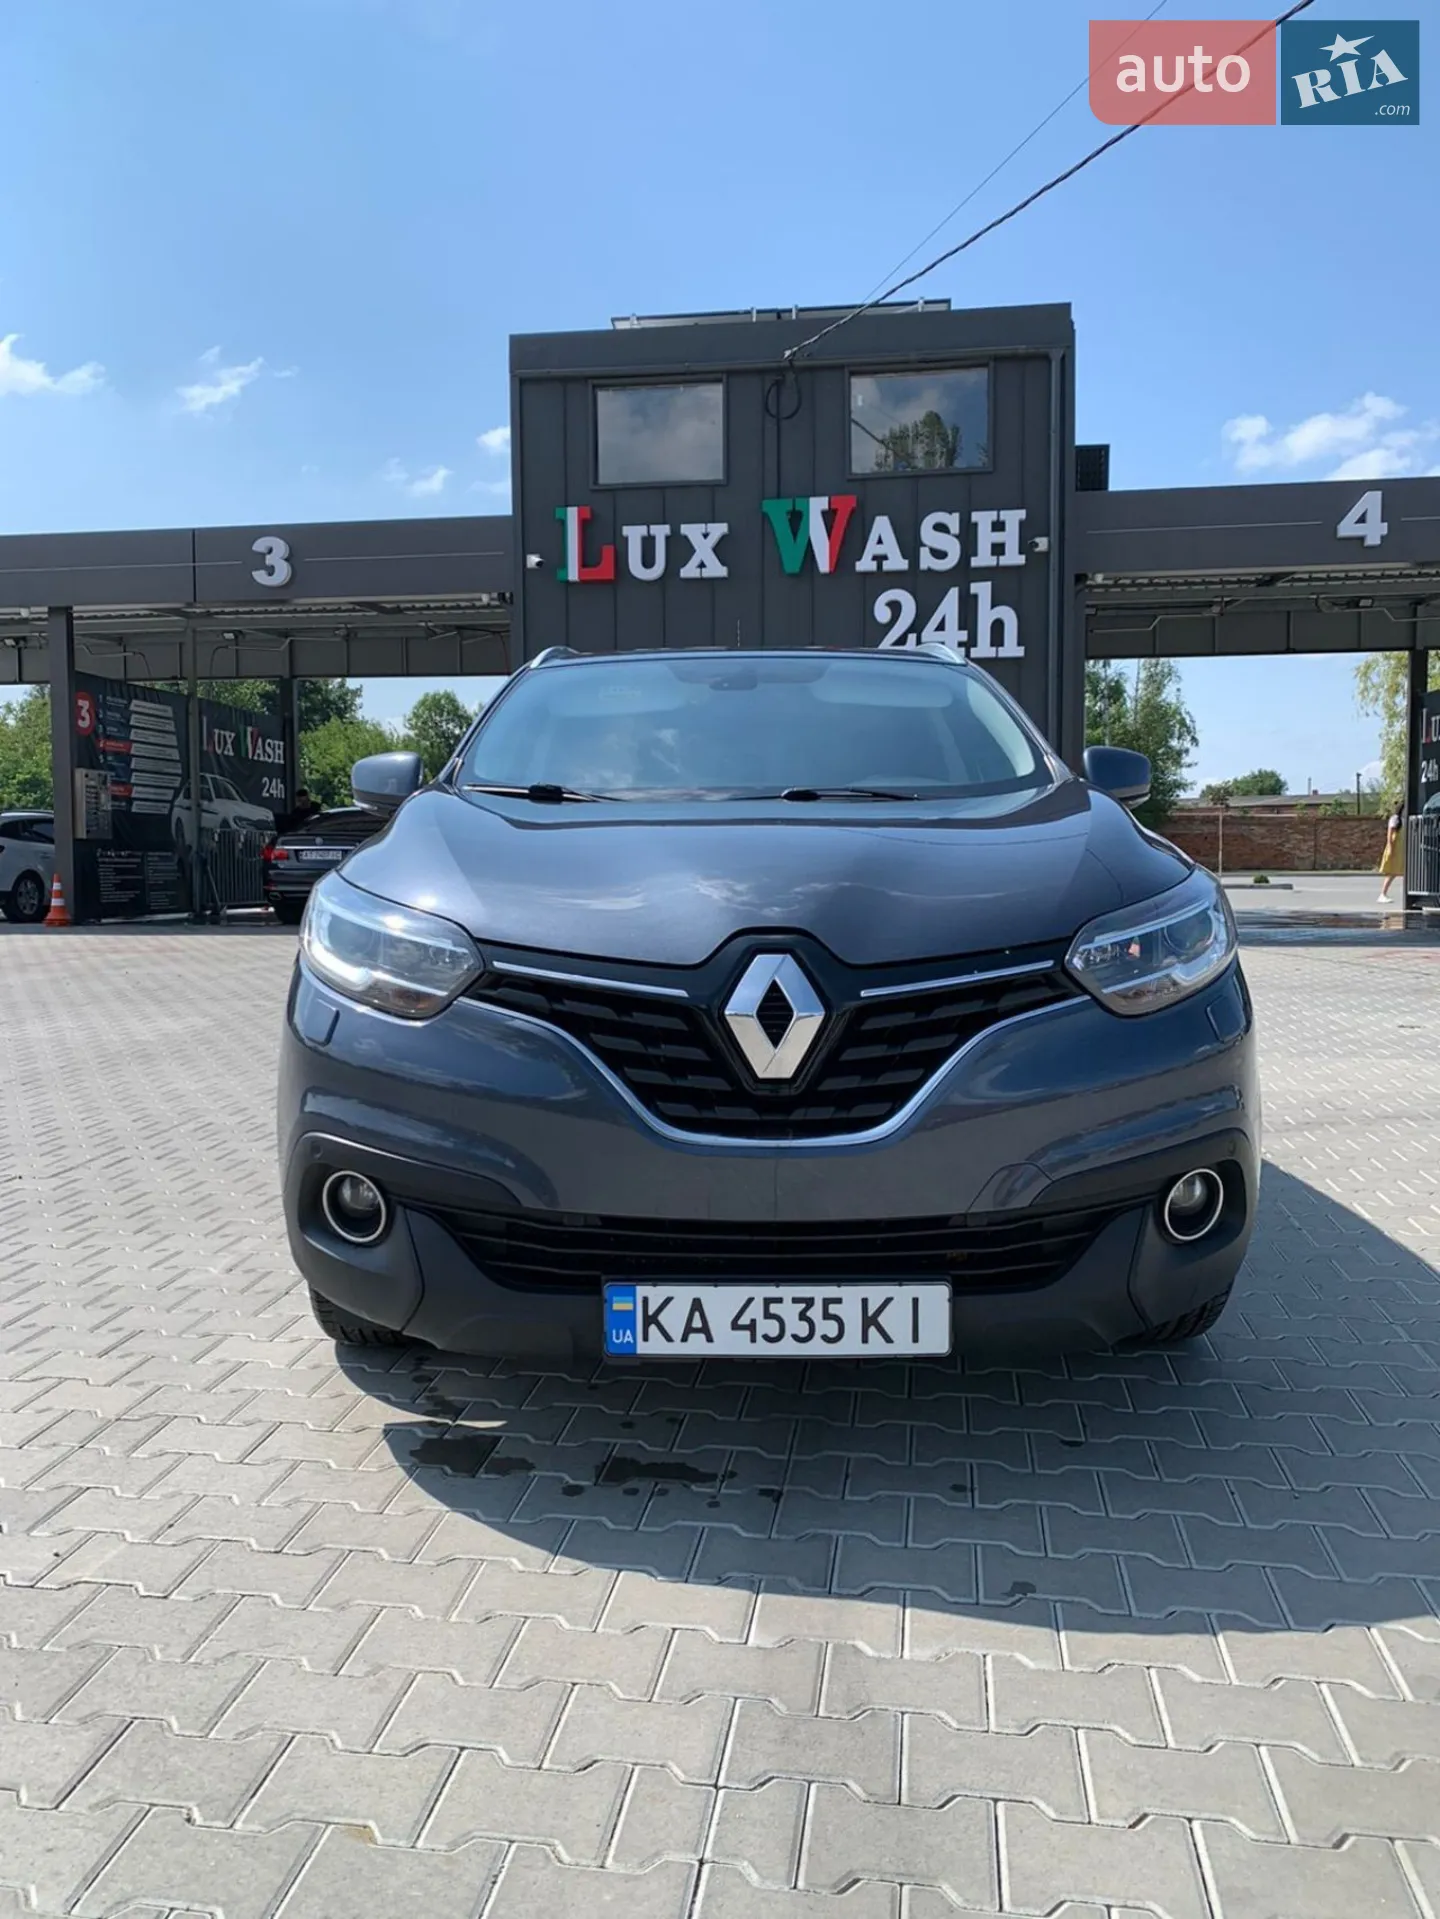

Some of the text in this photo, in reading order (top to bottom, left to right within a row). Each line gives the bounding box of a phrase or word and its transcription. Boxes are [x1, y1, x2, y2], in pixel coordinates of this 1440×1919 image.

[555, 495, 1027, 582] LUX WASH
[1336, 490, 1389, 547] 4
[251, 535, 292, 588] 3
[873, 580, 1026, 659] 24h
[77, 698, 91, 729] 3
[239, 726, 285, 765] WASH
[261, 776, 286, 799] 24h
[1420, 758, 1439, 783] 24h
[612, 1330, 634, 1344] UA
[641, 1296, 920, 1344] KA 4535 KI
